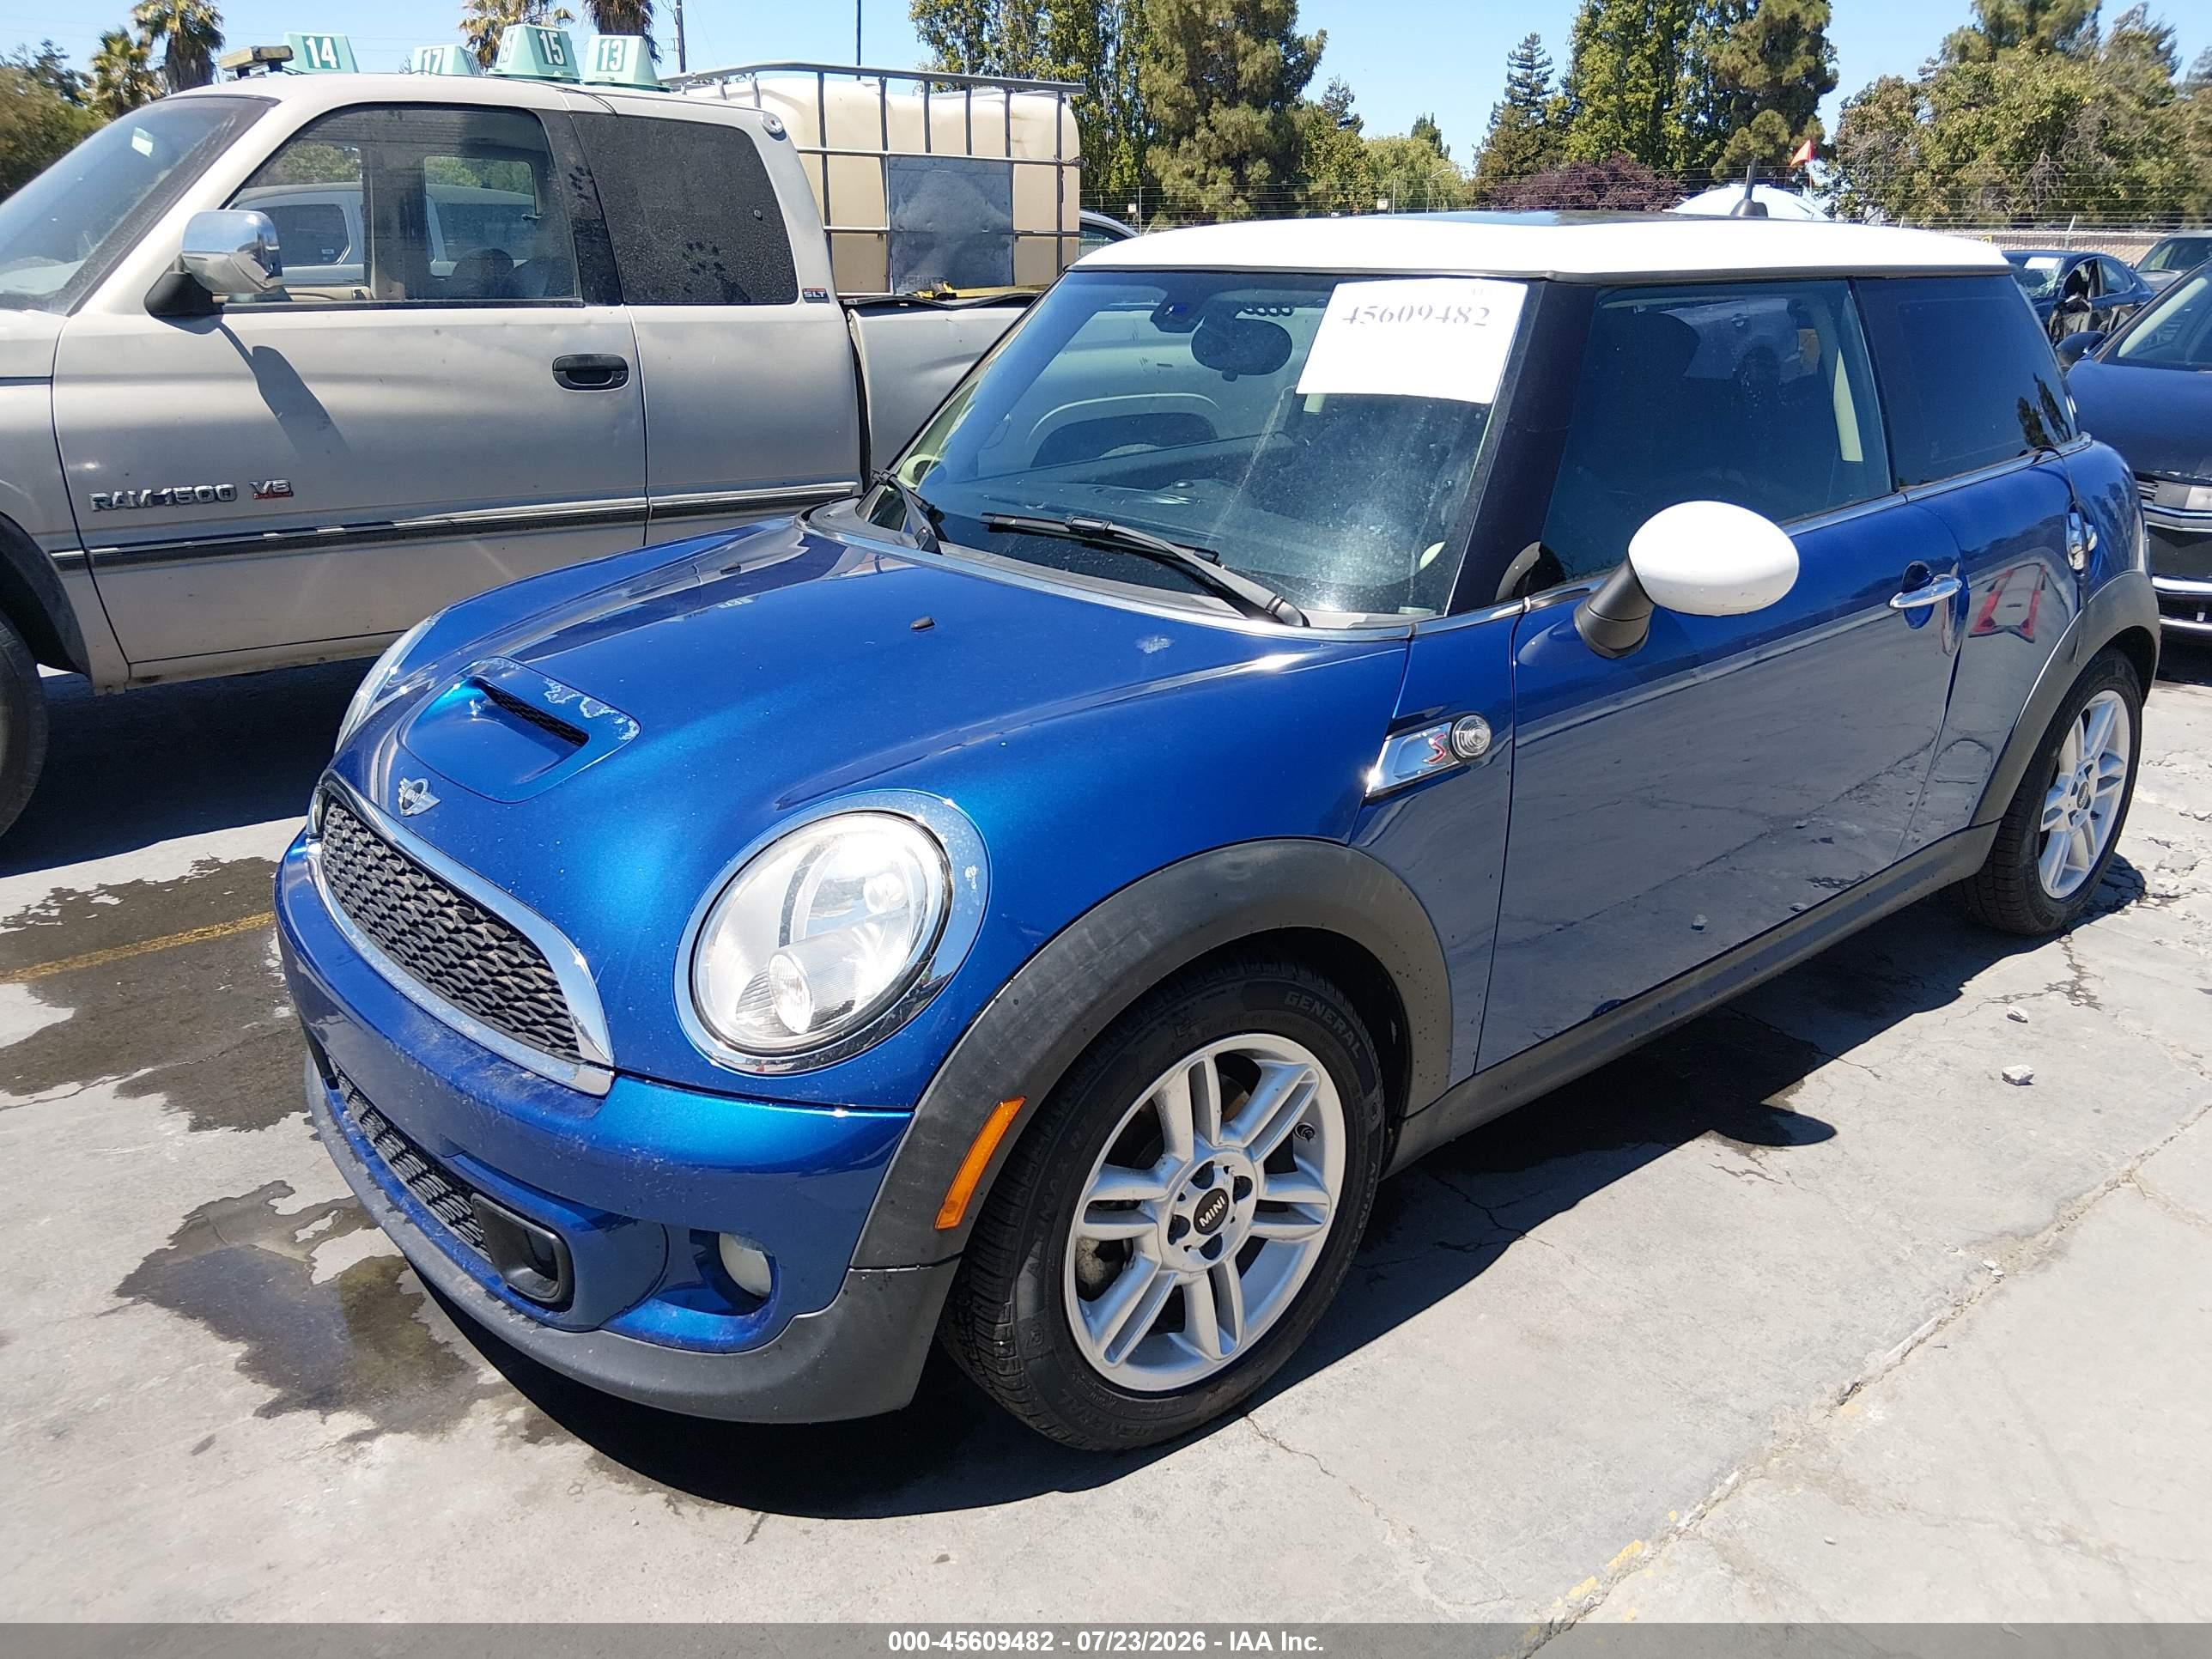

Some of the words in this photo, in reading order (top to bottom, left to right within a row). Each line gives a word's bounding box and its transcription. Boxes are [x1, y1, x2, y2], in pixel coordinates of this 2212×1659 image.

[305, 36, 337, 69] 14
[422, 48, 443, 75] 17
[539, 30, 565, 65] 15
[600, 39, 624, 71] 13
[1341, 305, 1491, 327] 45609482
[1423, 732, 1448, 765] S
[1284, 991, 1361, 1060] GENERAL
[1199, 1195, 1226, 1228] MINI
